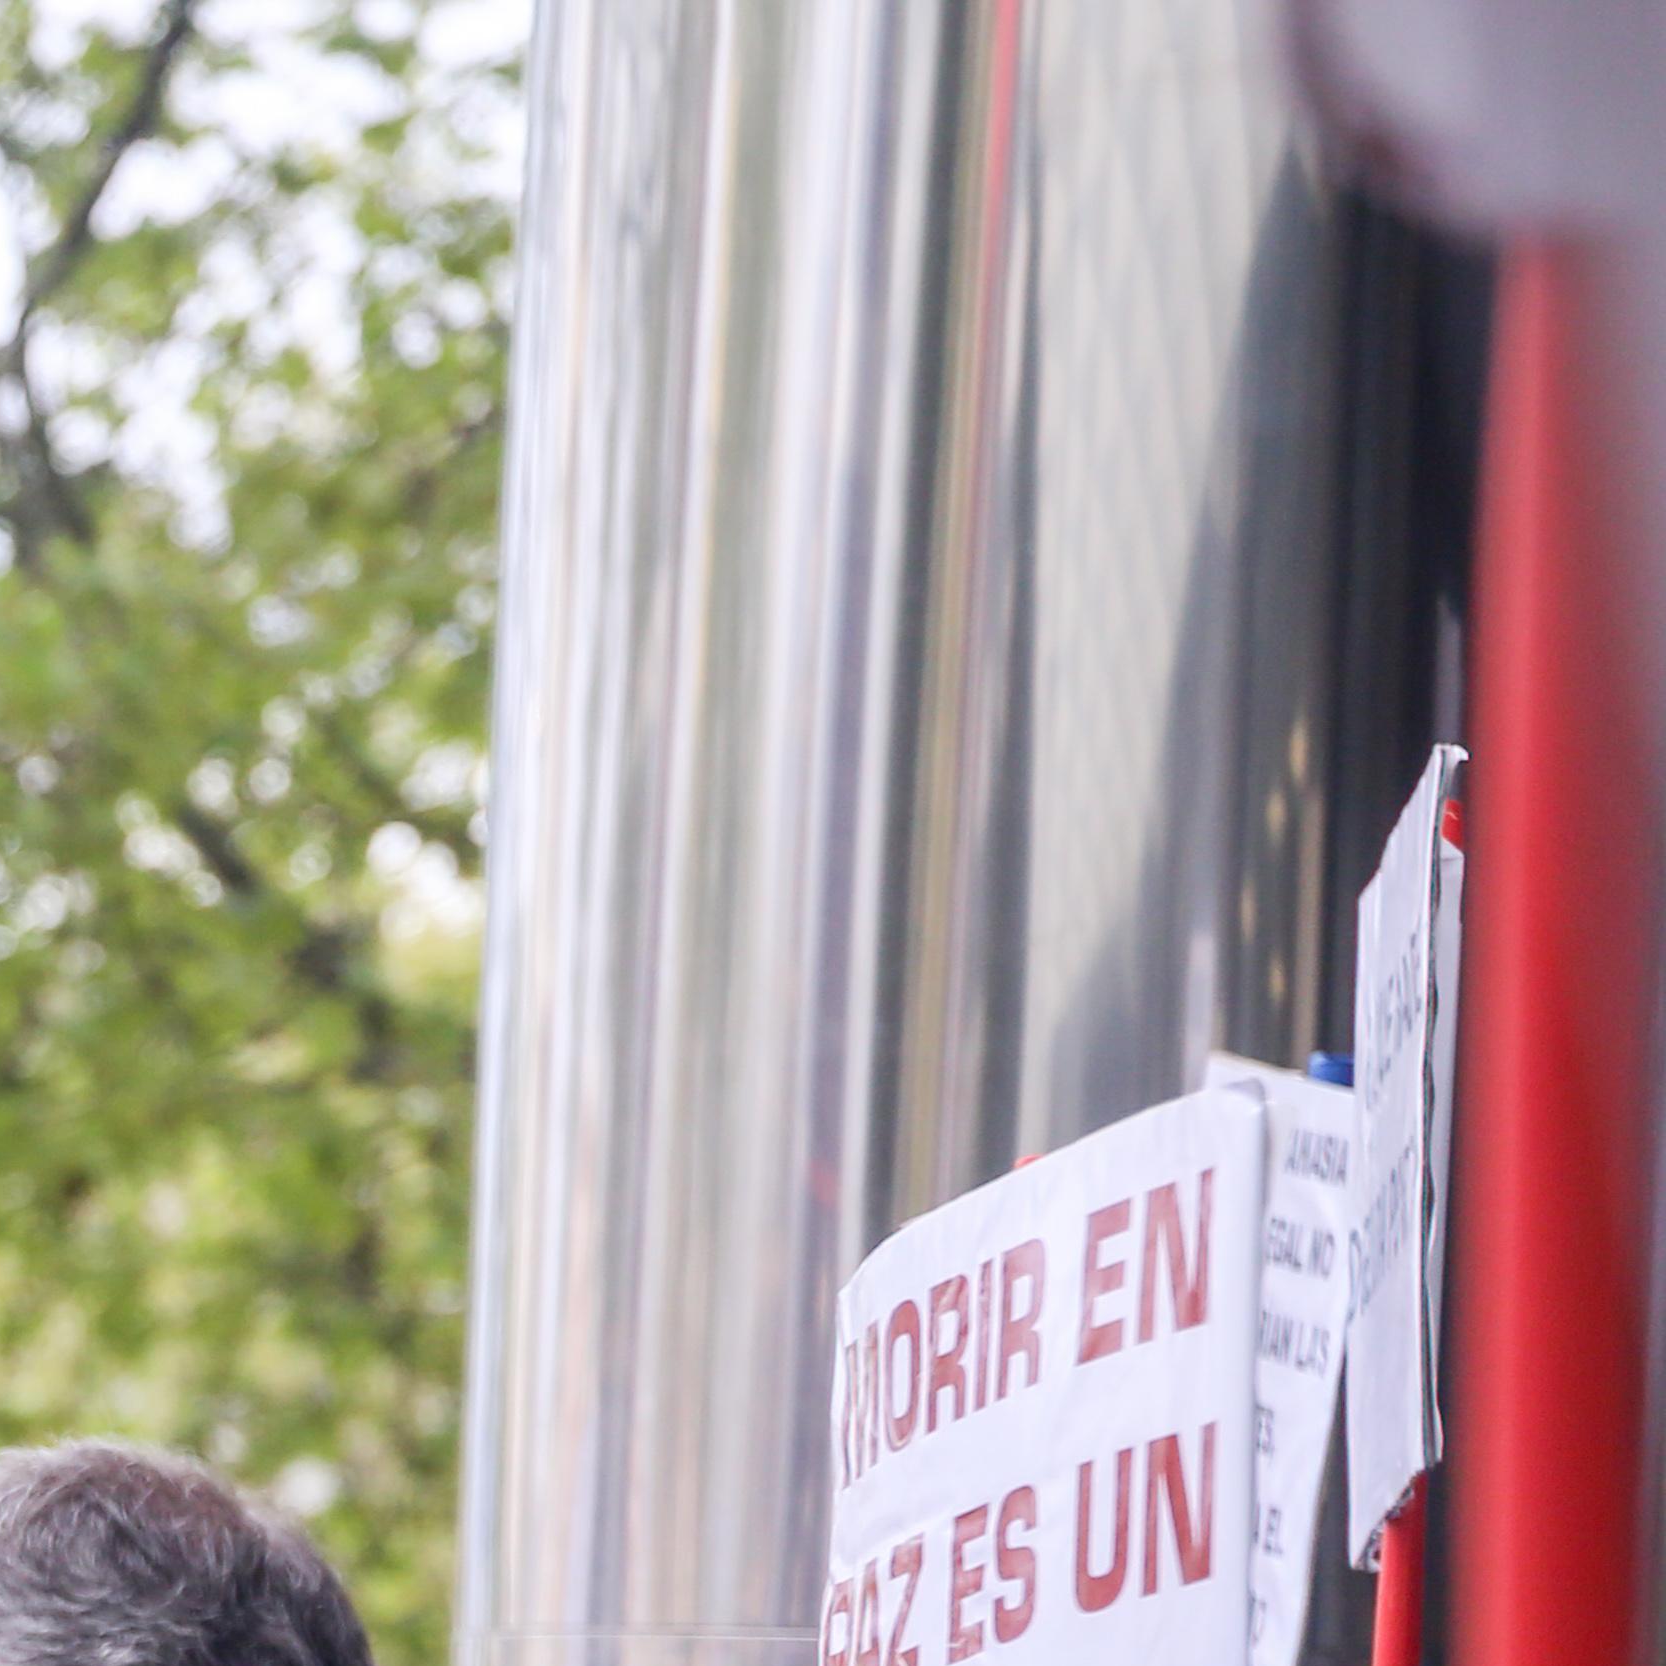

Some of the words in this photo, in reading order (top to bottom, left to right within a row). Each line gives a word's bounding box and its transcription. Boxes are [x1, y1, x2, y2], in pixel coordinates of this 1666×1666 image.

[839, 1237, 1046, 1490] MORIR
[1074, 1167, 1214, 1366] EN
[1264, 1215, 1302, 1272] EGAL
[946, 1484, 1037, 1666] ES
[1075, 1421, 1217, 1614] UN
